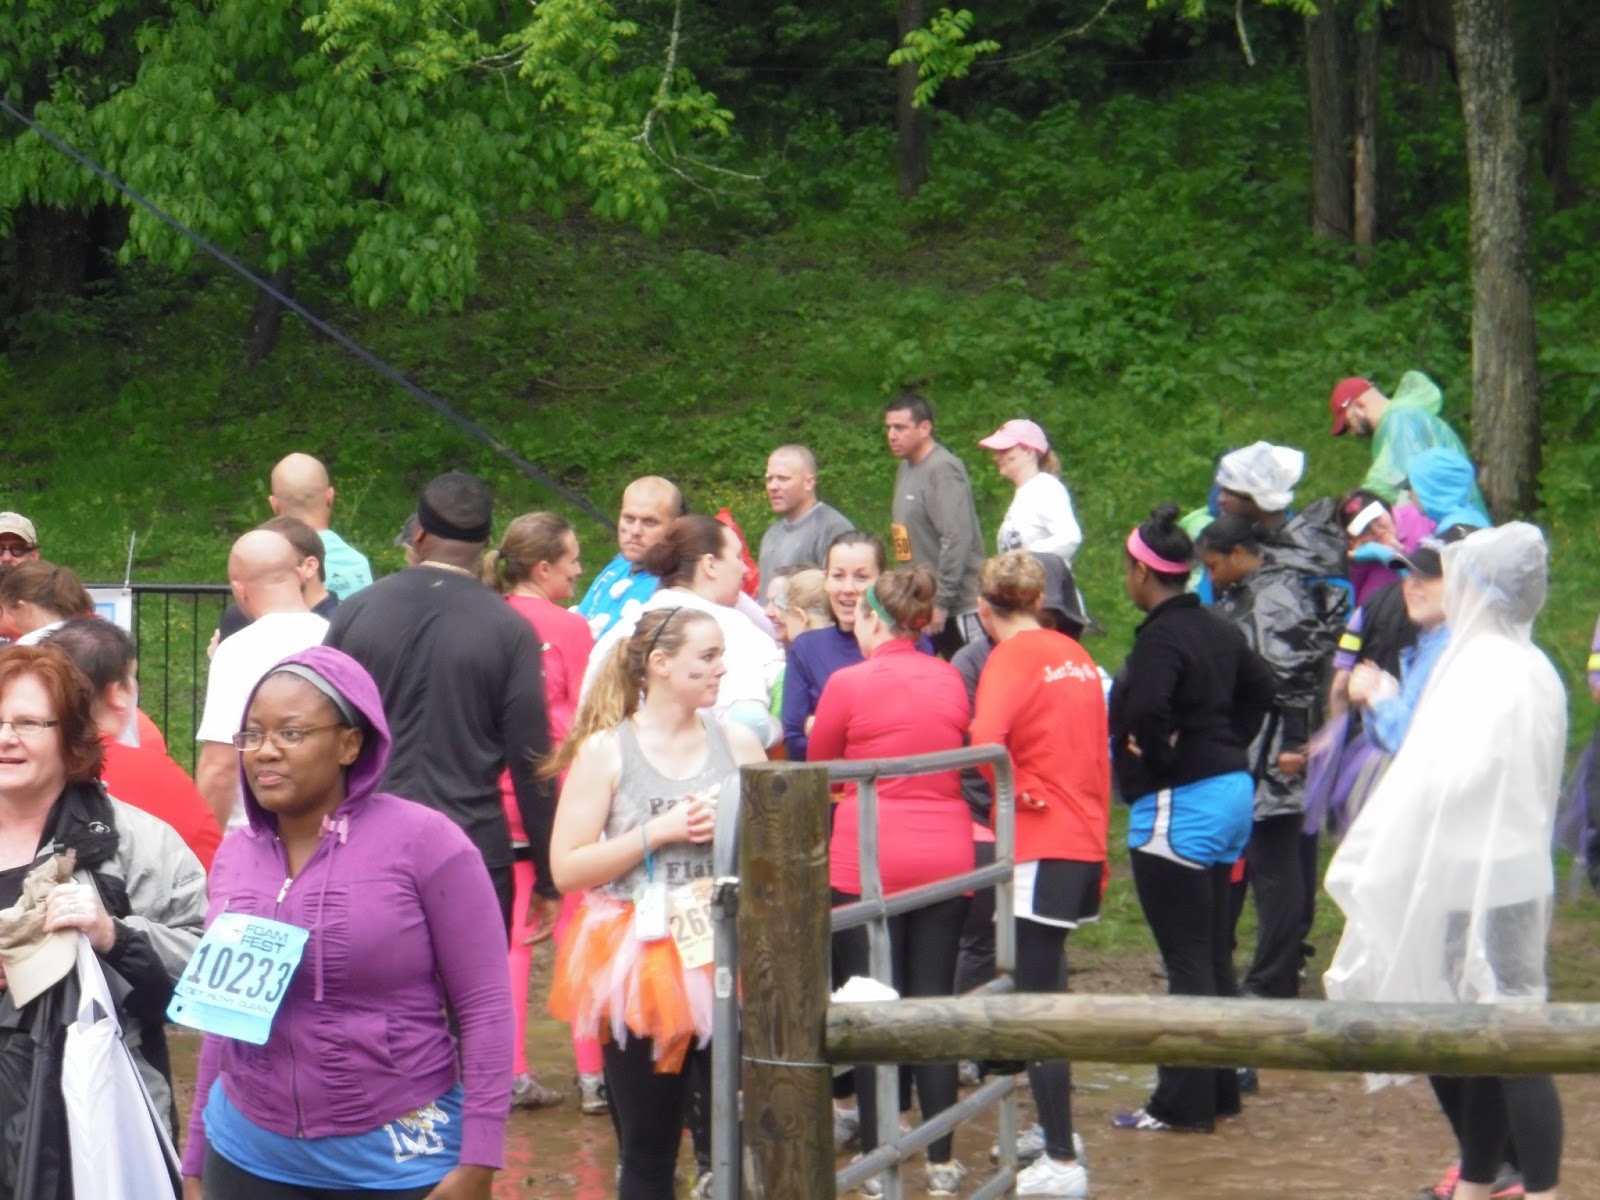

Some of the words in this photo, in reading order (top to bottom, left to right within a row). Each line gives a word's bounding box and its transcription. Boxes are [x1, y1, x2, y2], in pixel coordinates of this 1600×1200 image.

[666, 861, 714, 880] Flai
[244, 924, 289, 943] FOAM
[240, 934, 286, 954] FEST
[186, 943, 292, 1003] 10233
